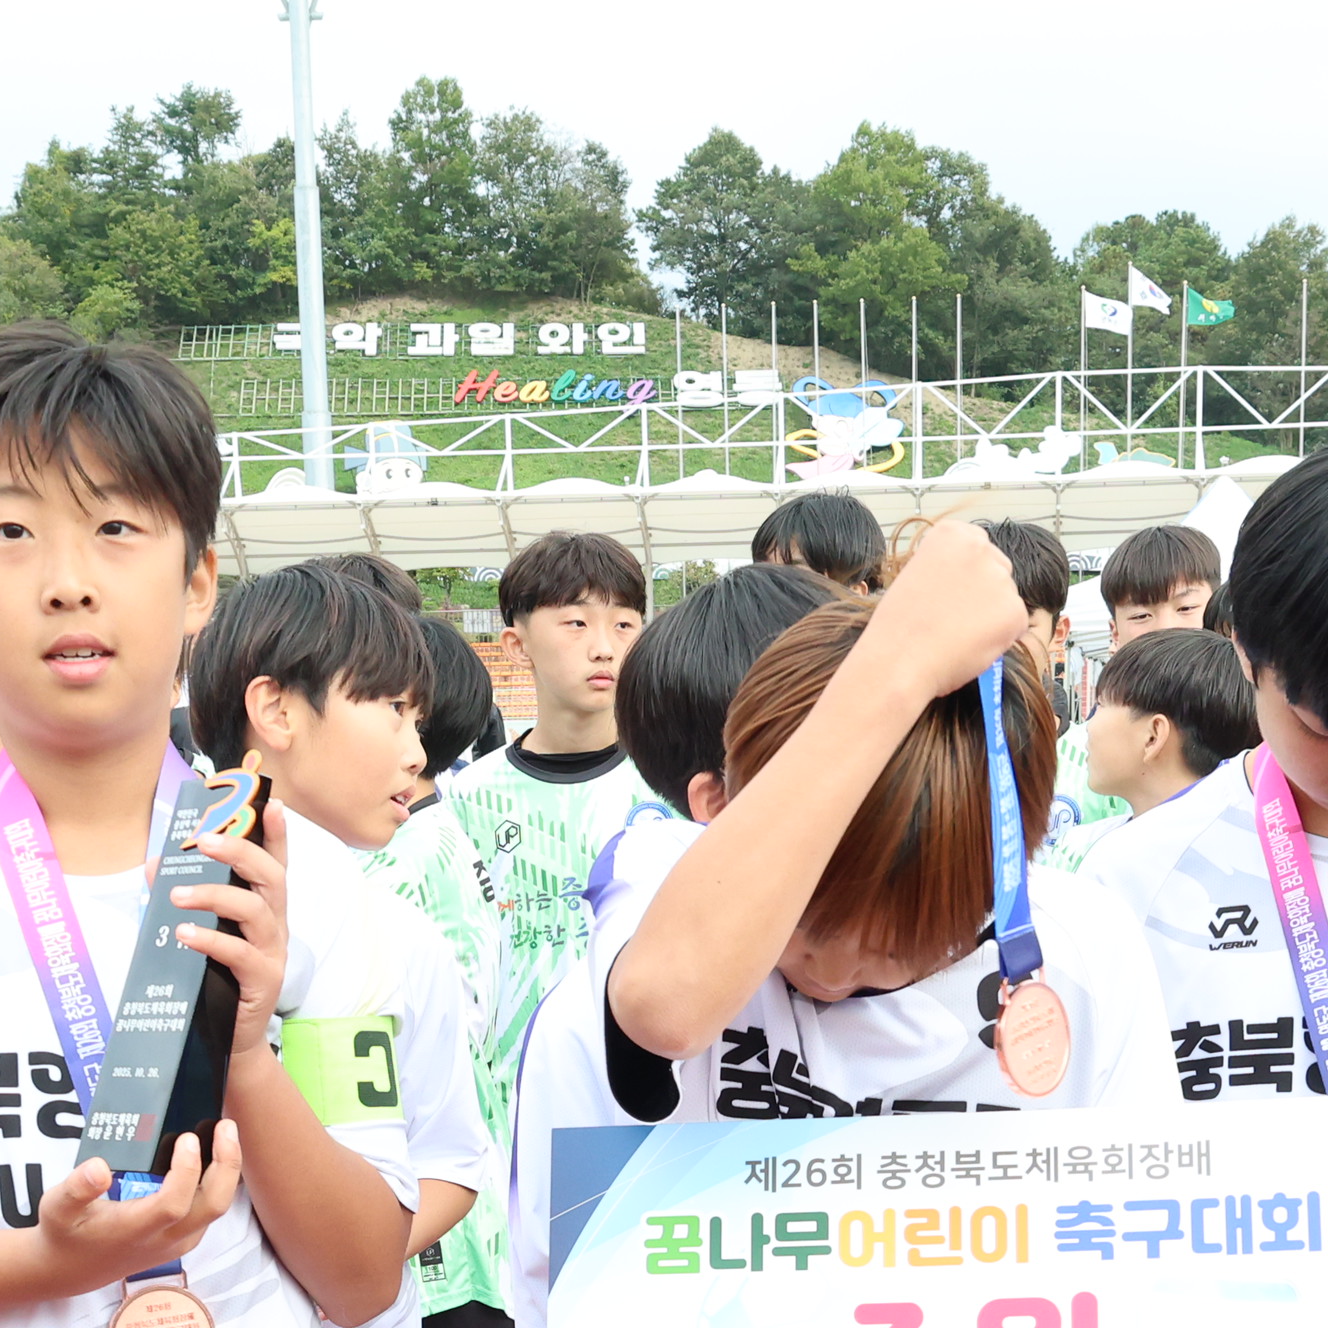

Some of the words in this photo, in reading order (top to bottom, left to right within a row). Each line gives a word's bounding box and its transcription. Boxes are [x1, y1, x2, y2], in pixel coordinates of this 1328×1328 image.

[407, 322, 515, 356] 과일
[537, 322, 646, 355] 와인
[454, 369, 657, 412] Healing
[1263, 799, 1304, 891] 꿈나무어린이축구대회
[5, 818, 61, 925] 꿈나무어린이축구대회
[155, 925, 170, 948] 3
[1208, 938, 1258, 951] WERUN
[1283, 886, 1326, 972] 충청북도체육회장배
[38, 919, 95, 1021] 충청북도체육회장배
[145, 984, 174, 998] 제26회
[69, 1019, 105, 1059] 제26회
[112, 1067, 133, 1079] 2025.
[744, 1152, 864, 1192] 제26회
[877, 1139, 1214, 1190] 충청북도체육회장배
[643, 1203, 1032, 1275] 꿈나무어린이
[1053, 1190, 1325, 1263] 축구대회
